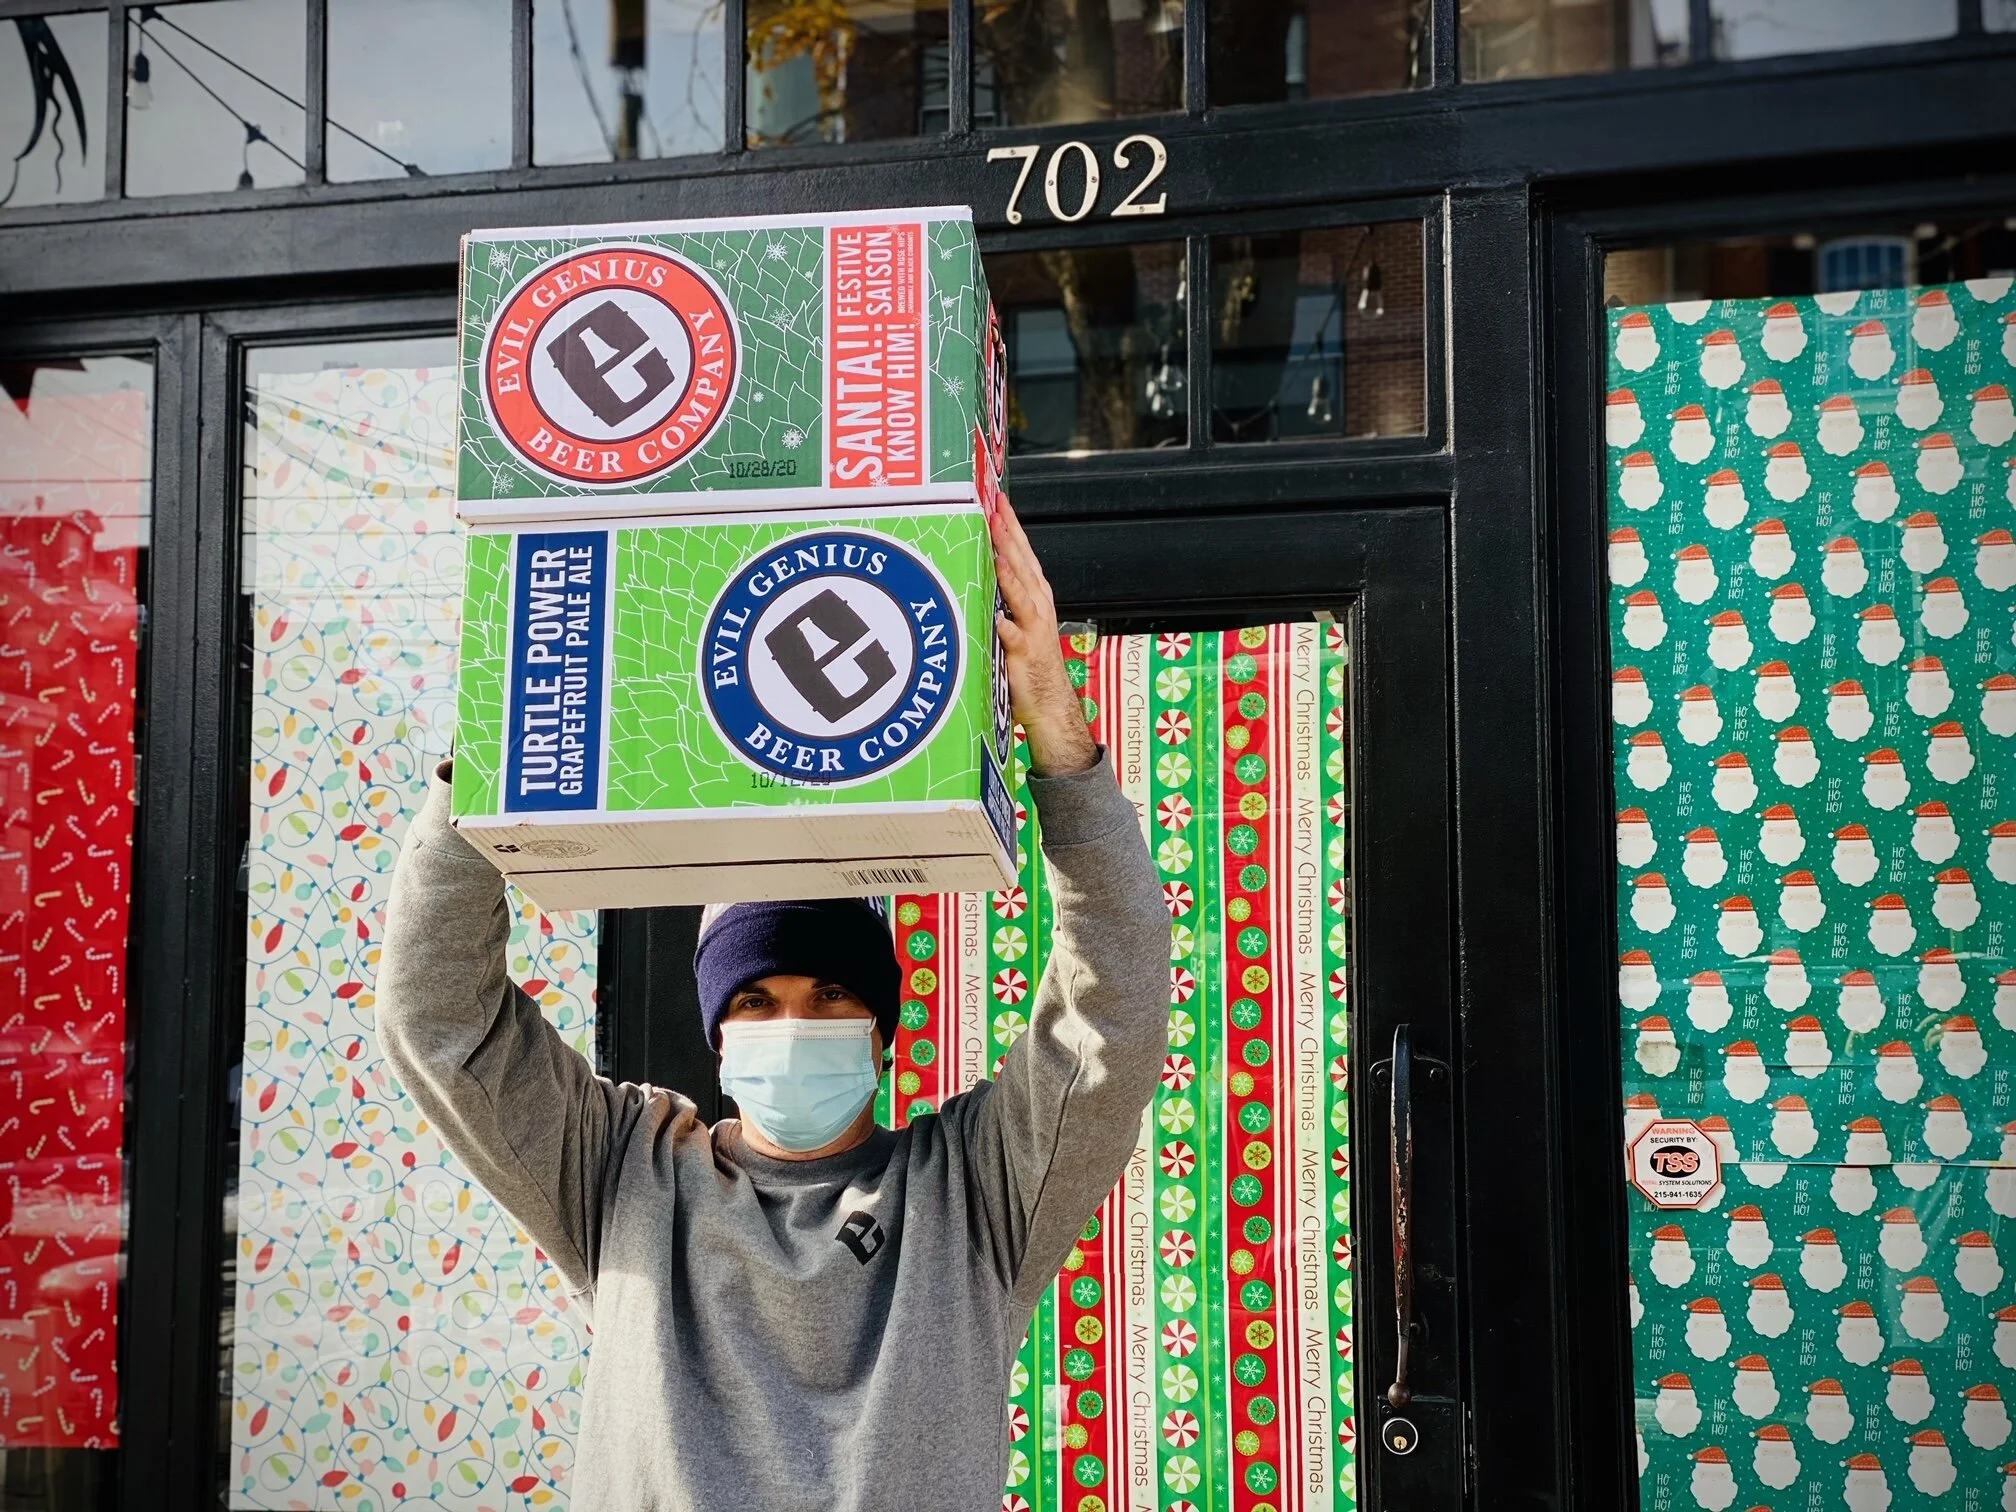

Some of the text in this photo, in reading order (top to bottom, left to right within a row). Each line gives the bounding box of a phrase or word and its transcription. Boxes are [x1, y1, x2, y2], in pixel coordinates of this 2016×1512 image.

[987, 134, 1167, 225] 702
[836, 232, 862, 317] FESTIVE
[866, 232, 893, 316] SAISON
[897, 267, 906, 285] WITH
[897, 286, 906, 313] BREWED
[497, 258, 668, 395] EVIL GENIUS
[1968, 339, 1981, 350] HO
[1967, 351, 1980, 363] HO
[1666, 361, 1681, 372] HO
[1964, 363, 1981, 375] HO!
[1667, 372, 1679, 384] HO
[527, 308, 725, 474] BEER COMPANY
[1665, 384, 1680, 395] HO!
[835, 323, 883, 480] SANTA!!
[886, 323, 916, 480] I KNOW HIM!
[1877, 416, 1891, 426] HO
[1727, 424, 1740, 435] HO
[1876, 428, 1889, 439] HO
[1726, 436, 1739, 447] HO
[1874, 439, 1890, 450] HO!
[1724, 447, 1740, 458] HO!
[729, 459, 797, 479] 10/28/20
[1972, 484, 1985, 494] HO
[1819, 492, 1832, 503] HO
[1972, 496, 1984, 507] HO
[1672, 500, 1684, 511] HO
[1818, 504, 1831, 515] HO
[1671, 512, 1683, 523] HO
[1970, 508, 1986, 519] HO!
[1816, 516, 1832, 526] HO!
[1669, 524, 1684, 534] HO!
[1882, 558, 1895, 569] HO
[1881, 570, 1894, 581] HO
[1879, 581, 1895, 593] HO!
[527, 548, 566, 663] POWER
[714, 543, 888, 690] EVIL GENIUS
[1824, 634, 1837, 645] HO
[1676, 641, 1688, 651] HO
[1823, 646, 1836, 657] HO
[1123, 634, 1144, 687] Merry
[1674, 652, 1687, 663] HO
[1821, 658, 1837, 669] HO!
[558, 545, 593, 795] GRAPEFRUIT PALE ALE
[1673, 664, 1688, 675] HO!
[744, 721, 845, 772] BEER
[859, 597, 948, 763] COMPANY
[1735, 706, 1748, 717] HO
[1886, 702, 1900, 712] HO
[1735, 718, 1747, 730] HO
[1886, 714, 1899, 725] HO
[520, 675, 561, 796] TURTLE
[1733, 730, 1748, 741] HO!
[1884, 726, 1900, 737] HO!
[1127, 694, 1145, 784] Christmas
[1829, 778, 1842, 788] HO
[1983, 774, 1997, 785] HO
[1680, 782, 1692, 792] HO
[1983, 786, 1996, 798] HO
[1679, 794, 1691, 805] HO
[1828, 790, 1840, 801] HO
[1826, 802, 1842, 812] HO!
[1980, 798, 1997, 810] HO!
[1677, 805, 1692, 816] HO!
[1740, 850, 1754, 860] HO
[1892, 847, 1906, 858] HO
[1740, 861, 1752, 873] HO
[1892, 859, 1905, 870] HO
[1738, 873, 1753, 884] HO!
[1890, 871, 1906, 882] HO!
[1684, 924, 1697, 935] HO
[1834, 923, 1848, 934] HO
[1684, 936, 1696, 947] HO
[1834, 935, 1846, 946] HO
[1681, 948, 1697, 958] HO!
[1832, 947, 1848, 958] HO!
[962, 892, 982, 1090] ristmas Merry Christ
[1746, 994, 1759, 1005] HO
[1898, 994, 1912, 1004] HO
[1745, 1006, 1758, 1017] HO
[1898, 1006, 1911, 1017] HO
[1743, 1018, 1759, 1029] HO!
[1896, 1018, 1912, 1029] HO!
[1293, 627, 1327, 1494] Merry Christmas Merry Christmas Merry Christmas Merry Christmas Merry Christmas
[1841, 1069, 1854, 1080] HO
[1840, 1082, 1853, 1093] HO
[1839, 1094, 1854, 1104] HO!
[1651, 1127, 1695, 1135] WARNING
[1653, 1152, 1698, 1173] TSS
[1128, 1148, 1147, 1205] Merry
[1796, 1180, 1809, 1191] HO
[1796, 1192, 1808, 1203] HO
[1794, 1204, 1810, 1215] HO!
[1130, 1212, 1149, 1306] Christmas
[1708, 1250, 1721, 1261] HO
[1860, 1253, 1872, 1264] HO
[1708, 1262, 1720, 1274] HO
[1860, 1266, 1872, 1277] HO
[1706, 1274, 1721, 1286] HO!
[1858, 1278, 1874, 1289] HO!
[1652, 1324, 1665, 1335] HO
[1802, 1329, 1816, 1340] HO
[1652, 1336, 1664, 1348] HO
[1958, 1333, 1972, 1345] HO
[1802, 1342, 1815, 1353] HO
[1957, 1346, 1970, 1358] HO
[1129, 1324, 1149, 1384] Merry
[1650, 1349, 1665, 1360] HO!
[1800, 1354, 1816, 1366] HO!
[1956, 1359, 1972, 1370] HO!
[1714, 1399, 1727, 1410] HO
[1714, 1411, 1726, 1422] HO
[1712, 1424, 1728, 1435] HO!
[1132, 1391, 1151, 1487] Christmas
[1657, 1474, 1670, 1485] HO
[1657, 1486, 1669, 1498] HO
[1655, 1499, 1670, 1511] HO!
